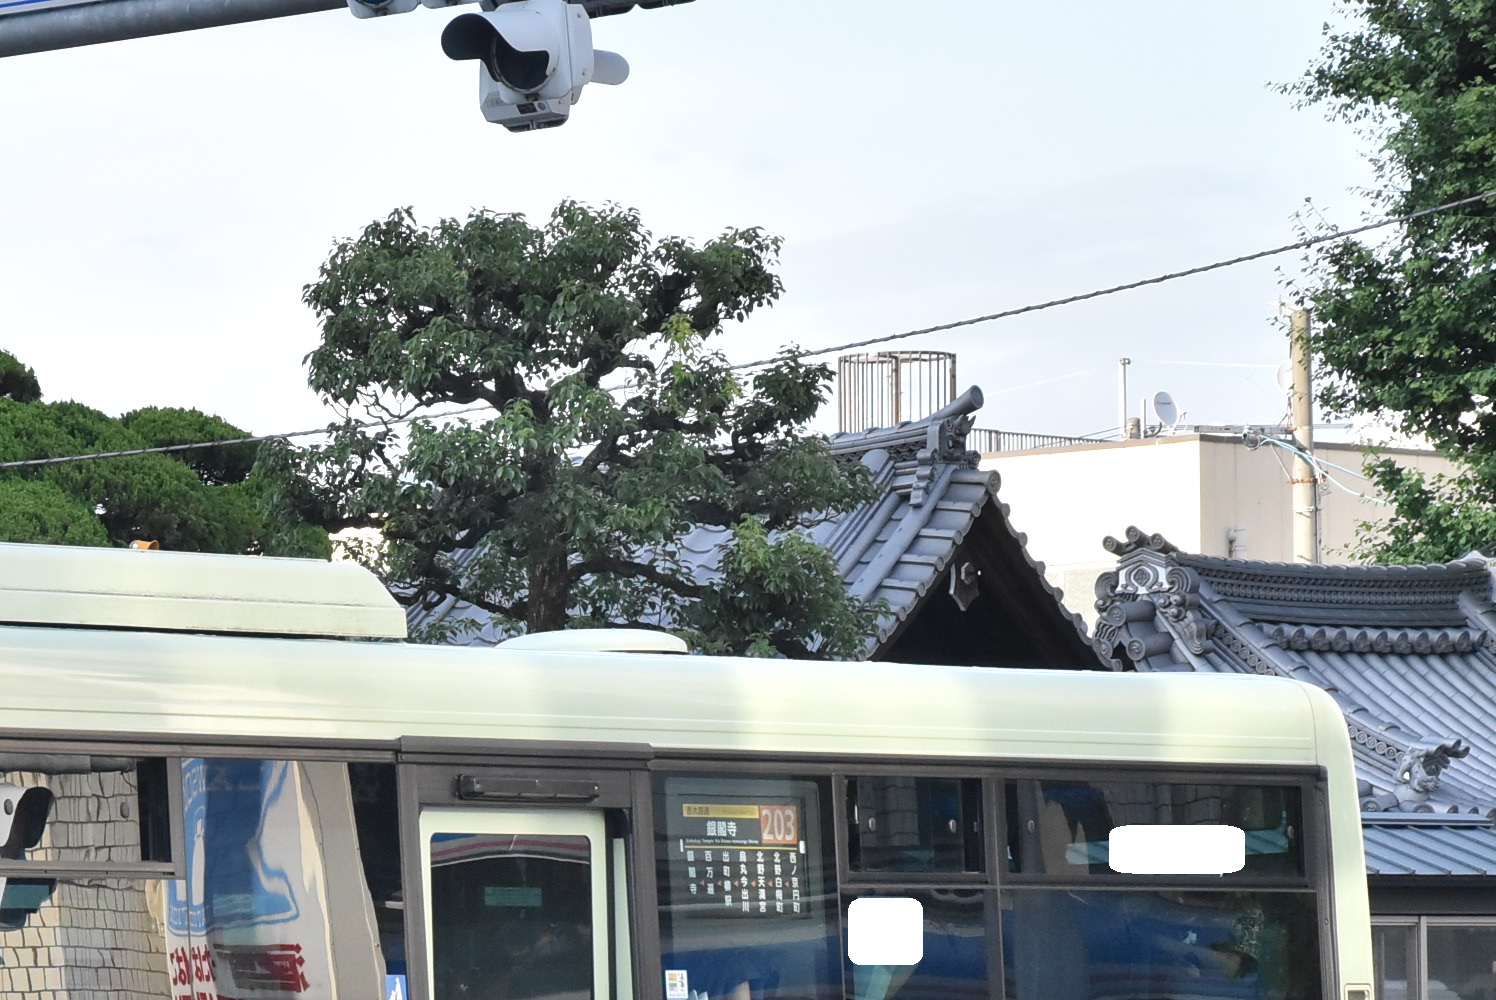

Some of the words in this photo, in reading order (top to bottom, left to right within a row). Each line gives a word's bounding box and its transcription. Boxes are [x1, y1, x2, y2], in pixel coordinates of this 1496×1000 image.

[706, 820, 737, 837] 銀閣寺
[763, 809, 795, 841] 203
